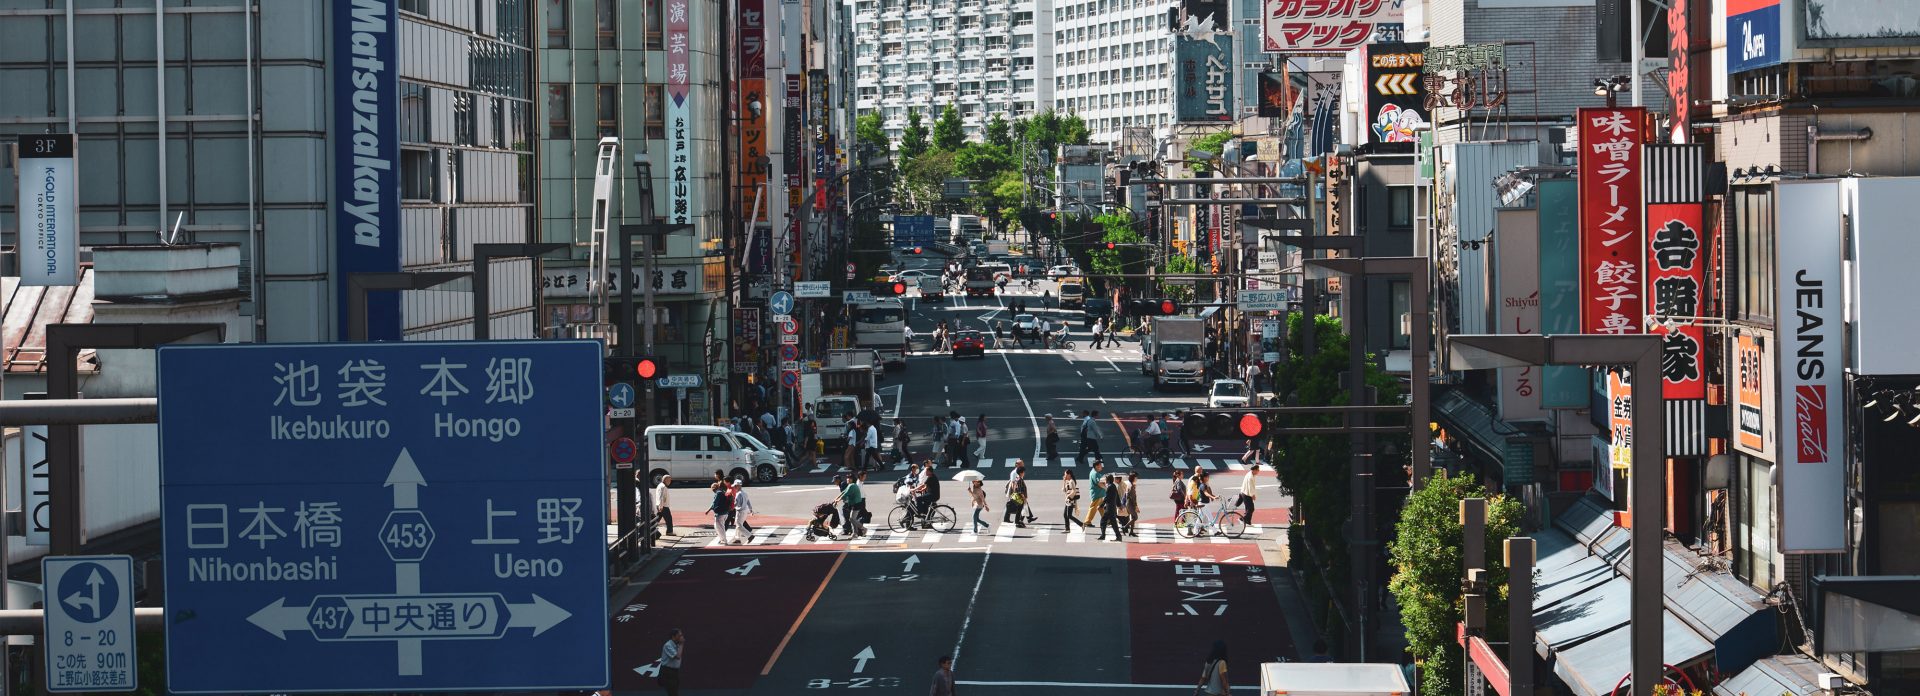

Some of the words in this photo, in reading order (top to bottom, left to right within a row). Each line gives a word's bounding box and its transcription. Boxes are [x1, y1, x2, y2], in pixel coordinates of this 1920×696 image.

[670, 2, 688, 85] 演芸場
[1280, 20, 1373, 47] マック
[1376, 24, 1405, 43] 24h
[1184, 59, 1197, 97] ホテル
[1422, 70, 1506, 111] まむし
[344, 0, 391, 248] Matsuzakaya
[34, 139, 57, 153] 3F
[45, 167, 55, 203] K-GOLD
[1239, 292, 1286, 303] 上野広小路
[1651, 219, 1699, 384] 吉野家
[1795, 269, 1825, 381] JEANS
[271, 358, 390, 408] 池袋
[419, 356, 535, 406] 本郷
[270, 413, 391, 440] Ikebukuro
[434, 411, 522, 443] Hongo
[185, 500, 343, 550] 日本橋
[470, 497, 586, 545] 上野
[385, 522, 429, 549] 453
[188, 554, 338, 582] Nihonbashi
[492, 552, 564, 580] Ueno
[311, 605, 350, 631] 437
[360, 600, 489, 632] 中央通り
[56, 654, 87, 673] この先
[96, 651, 128, 673] 90m
[56, 671, 128, 690] 上野広小路交差点
